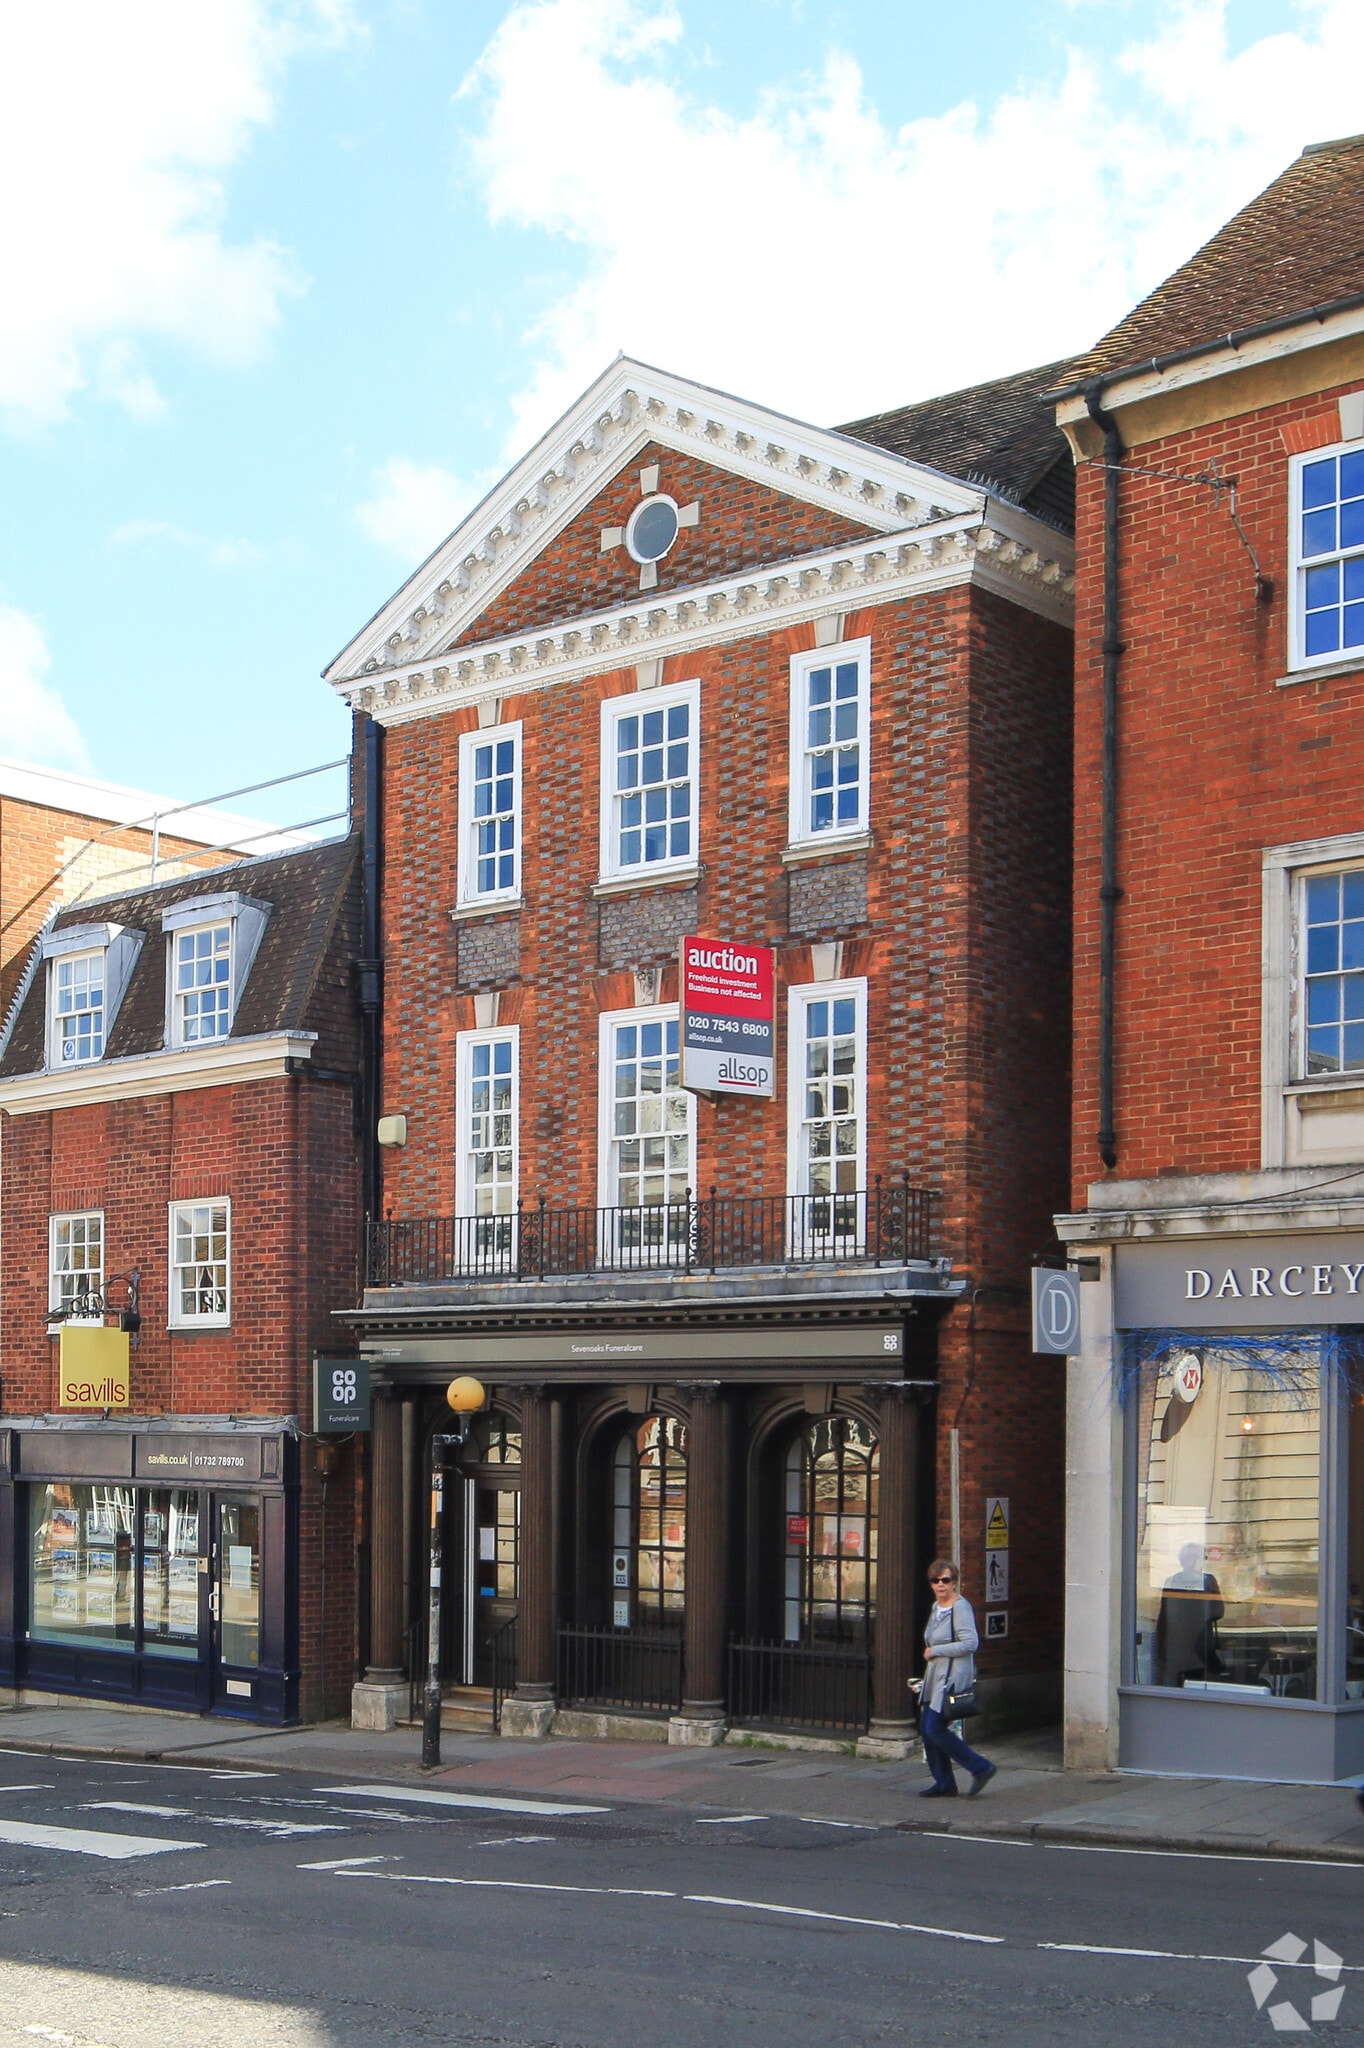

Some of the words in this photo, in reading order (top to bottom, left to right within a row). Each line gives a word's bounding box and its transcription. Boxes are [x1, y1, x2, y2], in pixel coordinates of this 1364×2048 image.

[688, 948, 757, 975] auction
[688, 972, 718, 984] Freehold
[719, 976, 757, 989] investment
[688, 983, 719, 994] Business
[720, 988, 732, 997] not
[733, 989, 762, 1000] affected
[688, 1016, 709, 1029] 020
[712, 1019, 739, 1033] 7543
[742, 1023, 769, 1037] 6800
[688, 1032, 723, 1043] allsop.co.uk
[718, 1058, 768, 1087] allsop
[1185, 1263, 1364, 1299] DARCEY
[1049, 1289, 1072, 1334] D
[571, 1344, 604, 1353] Sevenoaks
[605, 1343, 643, 1352] Funeralcare
[66, 1378, 126, 1403] savills
[329, 1414, 360, 1422] Funeralcare
[148, 1453, 188, 1465] savills.co.uk
[194, 1456, 216, 1466] 01732
[218, 1456, 244, 1467] 789700
